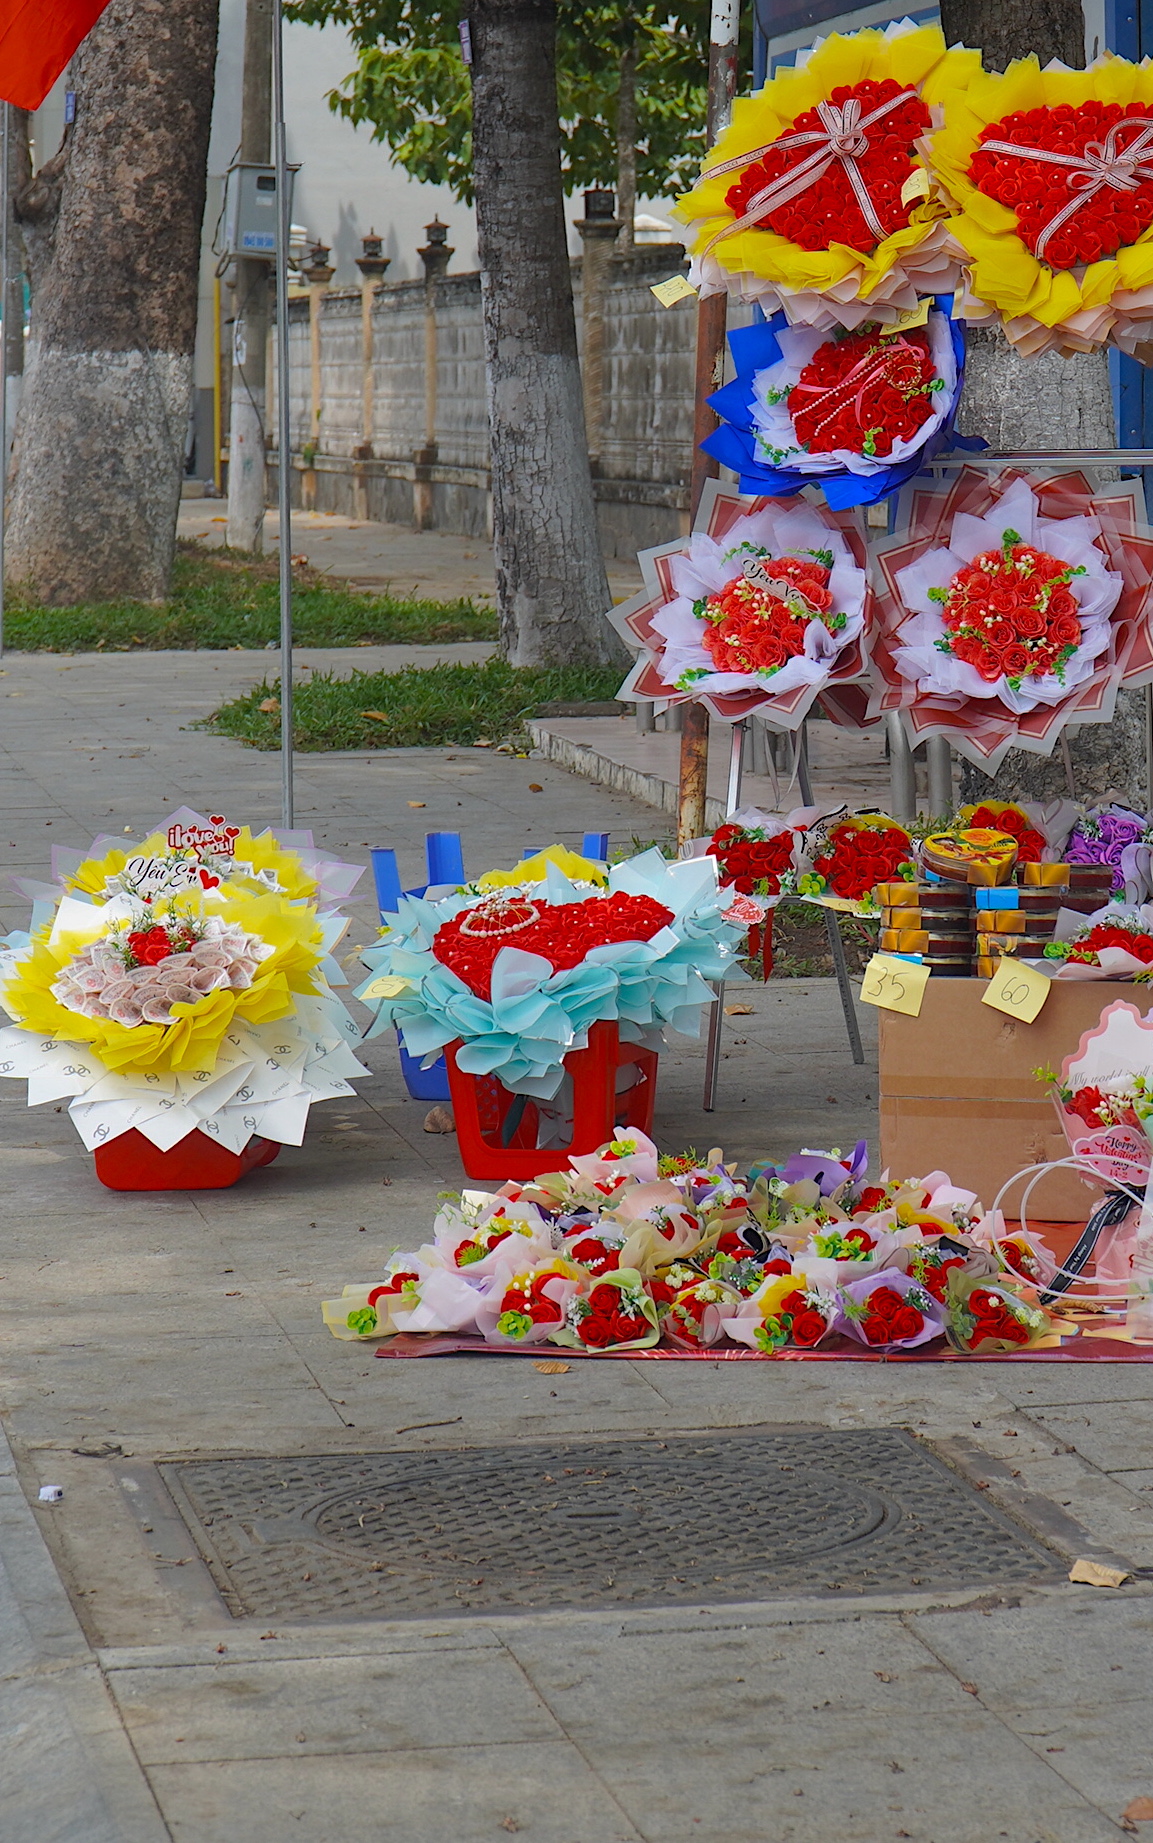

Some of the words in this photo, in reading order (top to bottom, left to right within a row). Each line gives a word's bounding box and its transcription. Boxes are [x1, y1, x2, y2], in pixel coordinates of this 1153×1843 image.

[128, 858, 166, 887] Yêu
[866, 966, 911, 1001] 35
[1001, 976, 1030, 1005] 60
[1071, 1071, 1087, 1087] My
[1105, 1136, 1139, 1152] Happy
